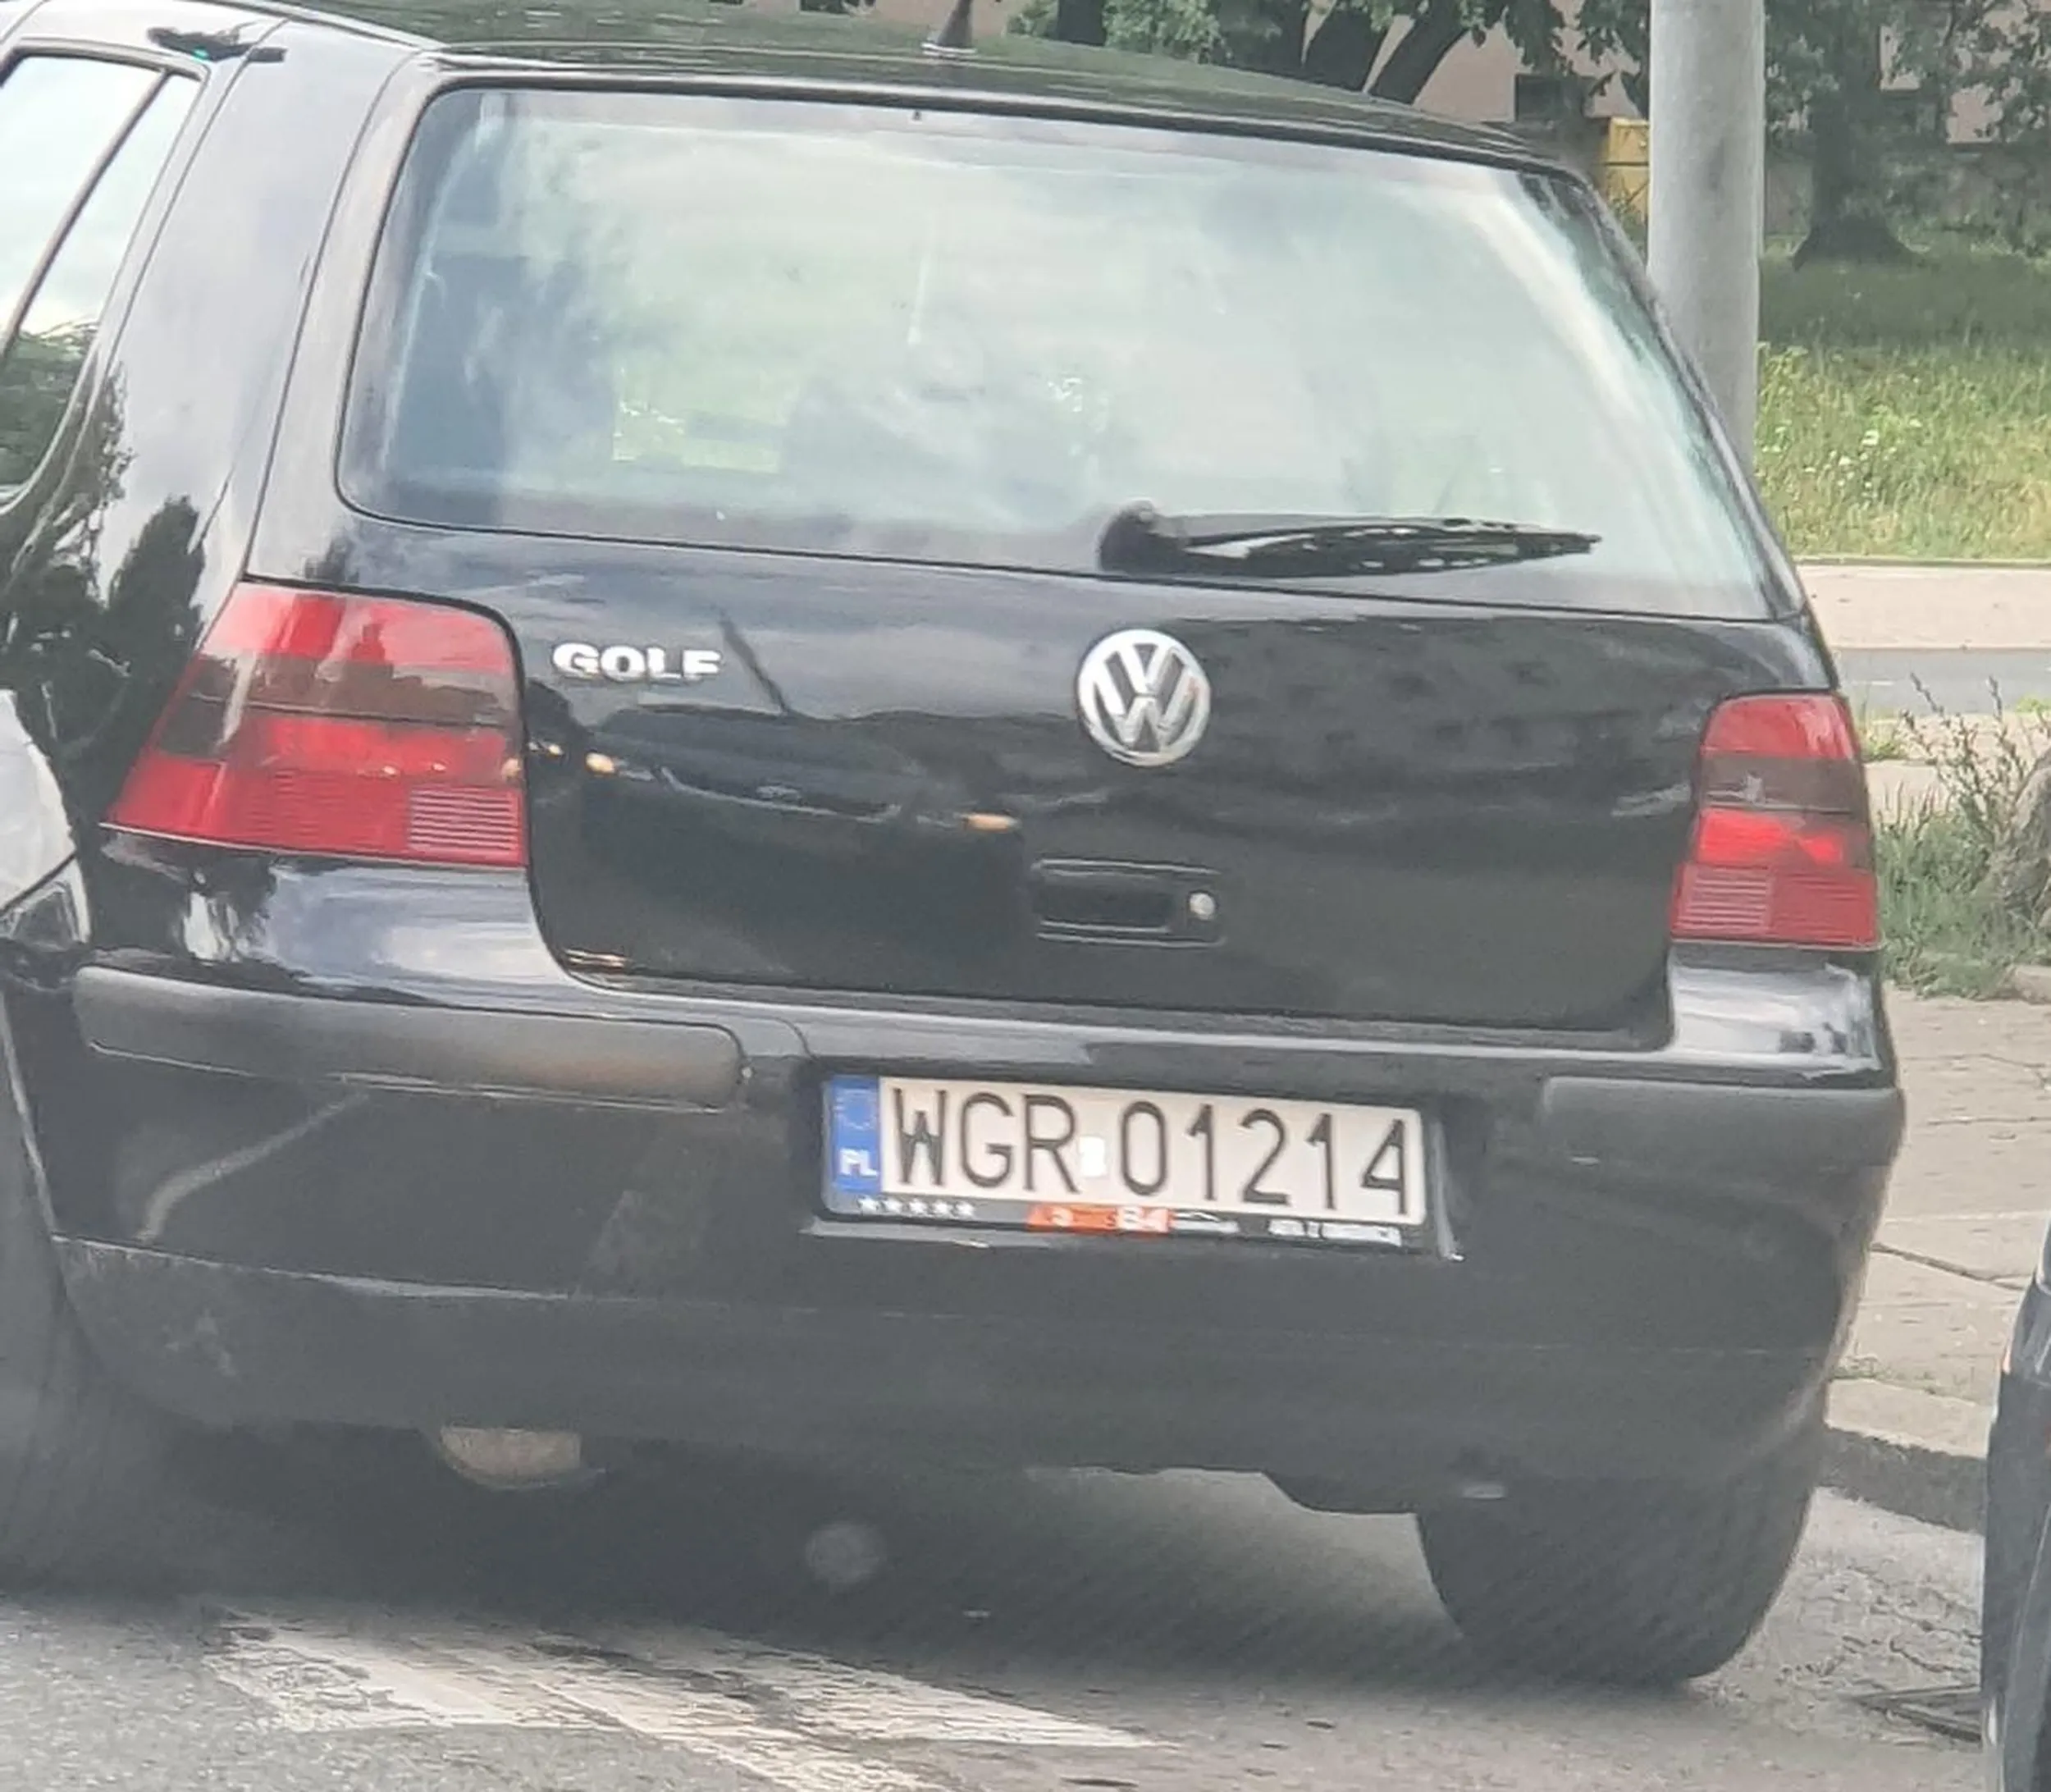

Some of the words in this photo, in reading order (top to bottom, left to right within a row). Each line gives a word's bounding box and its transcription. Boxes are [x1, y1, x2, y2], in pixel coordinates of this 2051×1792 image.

[552, 642, 722, 683] GOLF
[1078, 629, 1210, 767] VW
[839, 1148, 877, 1176] PL
[892, 1087, 1080, 1193] WGR
[1120, 1100, 1408, 1215] 01214
